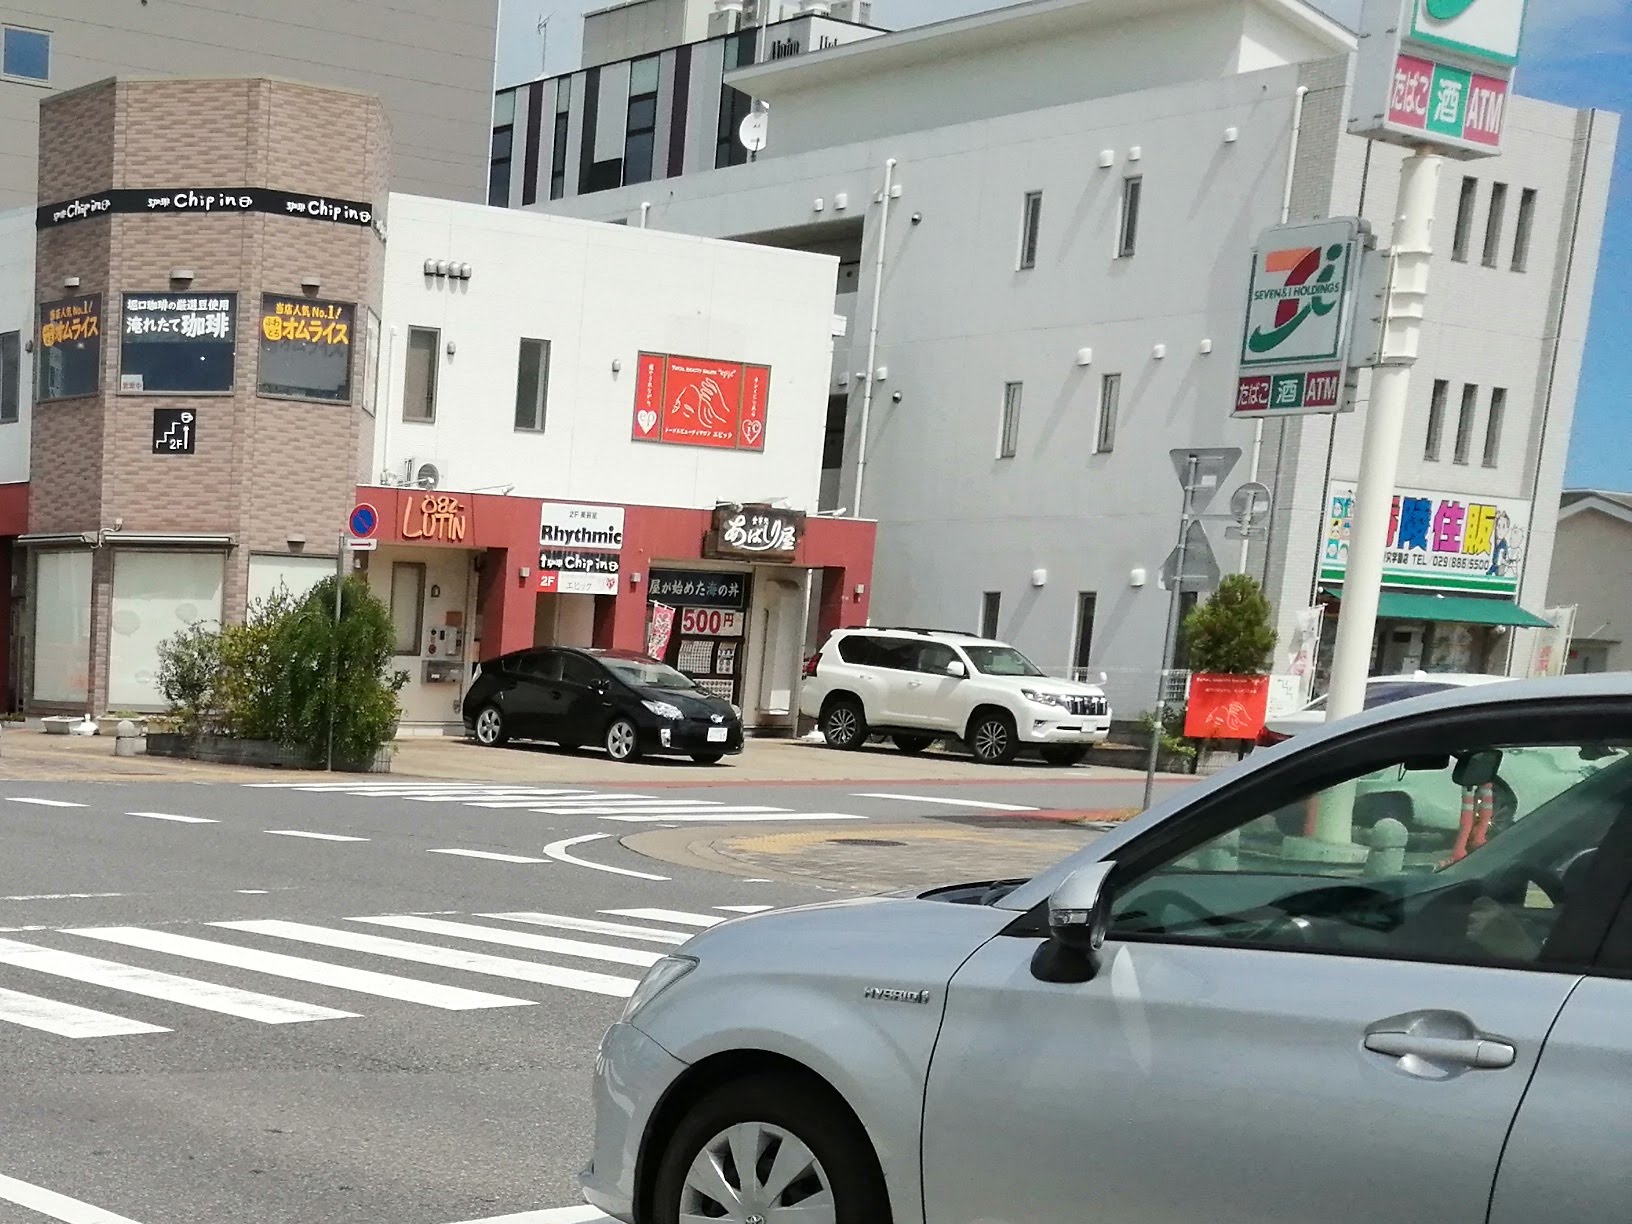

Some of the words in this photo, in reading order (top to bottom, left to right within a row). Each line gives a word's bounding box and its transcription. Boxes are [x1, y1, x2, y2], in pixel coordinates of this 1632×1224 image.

[1391, 68, 1429, 116] たばこ
[1434, 78, 1462, 123] 酒
[1467, 87, 1504, 134] ATM
[173, 190, 215, 211] Chip
[219, 193, 237, 208] in
[307, 199, 342, 221] Chip
[344, 205, 359, 220] in
[1293, 282, 1340, 296] HOLDINGS
[55, 315, 99, 343] オムライス
[126, 312, 230, 338] 淹れたて珈琲
[282, 316, 349, 345] オムライス
[1237, 382, 1269, 406] たばこ
[1275, 379, 1299, 404] 酒
[1305, 376, 1338, 401] ATM
[169, 438, 183, 450] 2F
[541, 525, 622, 545] Rhythmic
[564, 553, 594, 572] Chip
[595, 558, 608, 570] in
[1412, 555, 1428, 567] TEL
[539, 575, 556, 587] 2F
[682, 609, 734, 634] 500円
